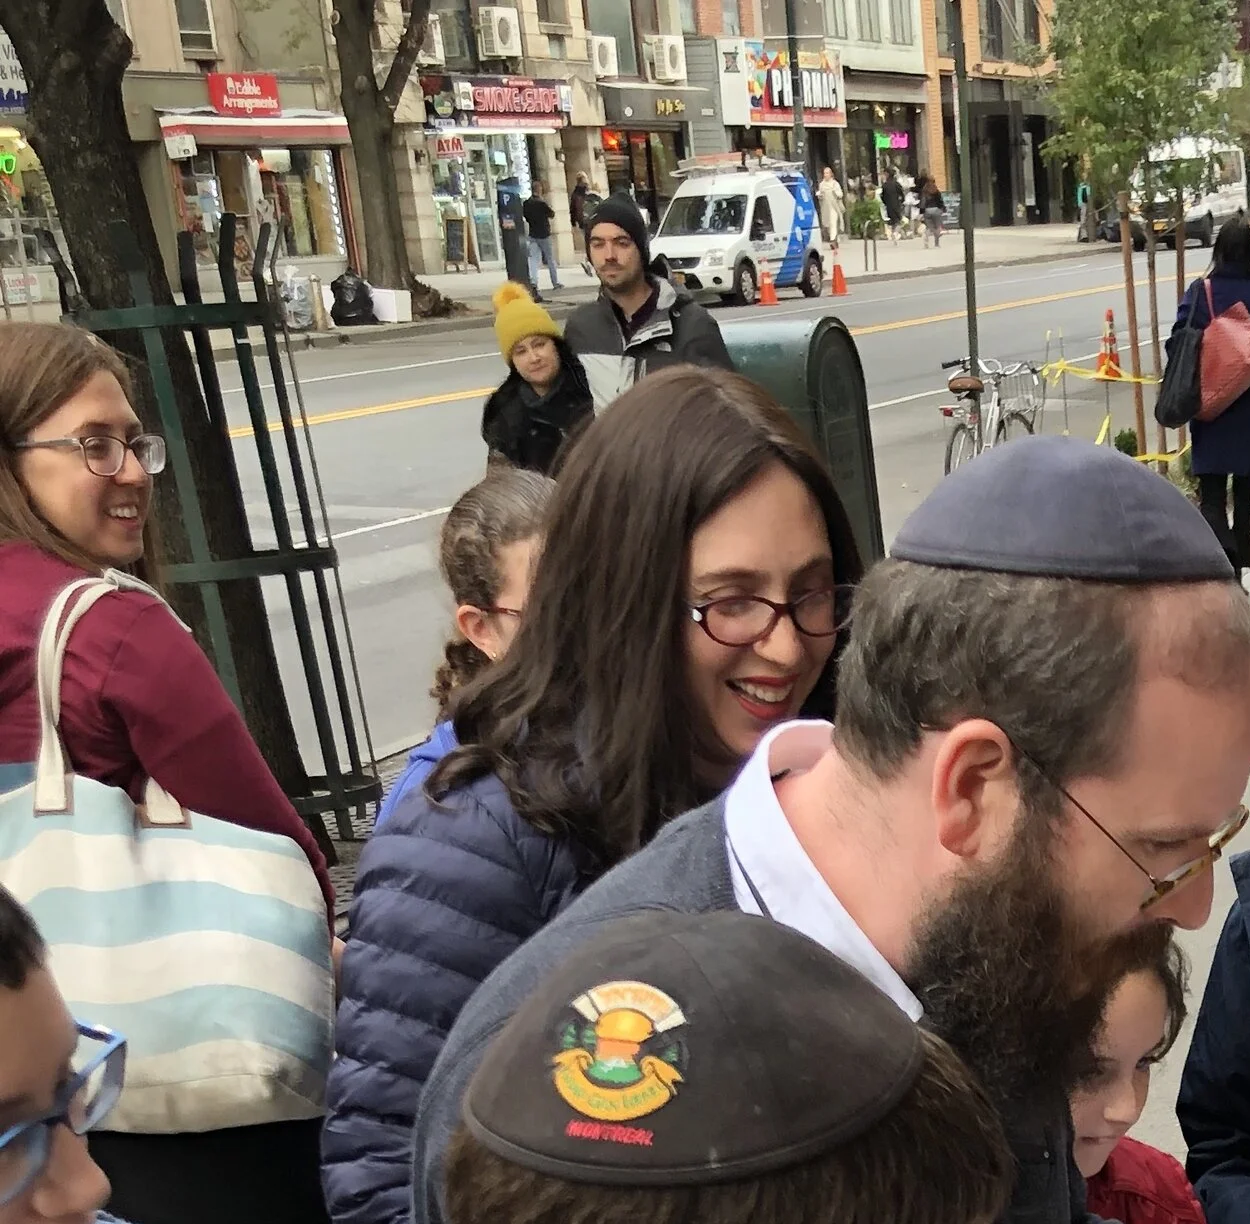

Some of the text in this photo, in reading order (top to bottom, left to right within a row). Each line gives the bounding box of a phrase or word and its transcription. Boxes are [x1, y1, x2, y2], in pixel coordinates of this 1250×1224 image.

[236, 78, 262, 95] Edible
[222, 97, 279, 114] Arrangements
[474, 87, 560, 113] SMOKE SHOP
[436, 137, 463, 154] ATM
